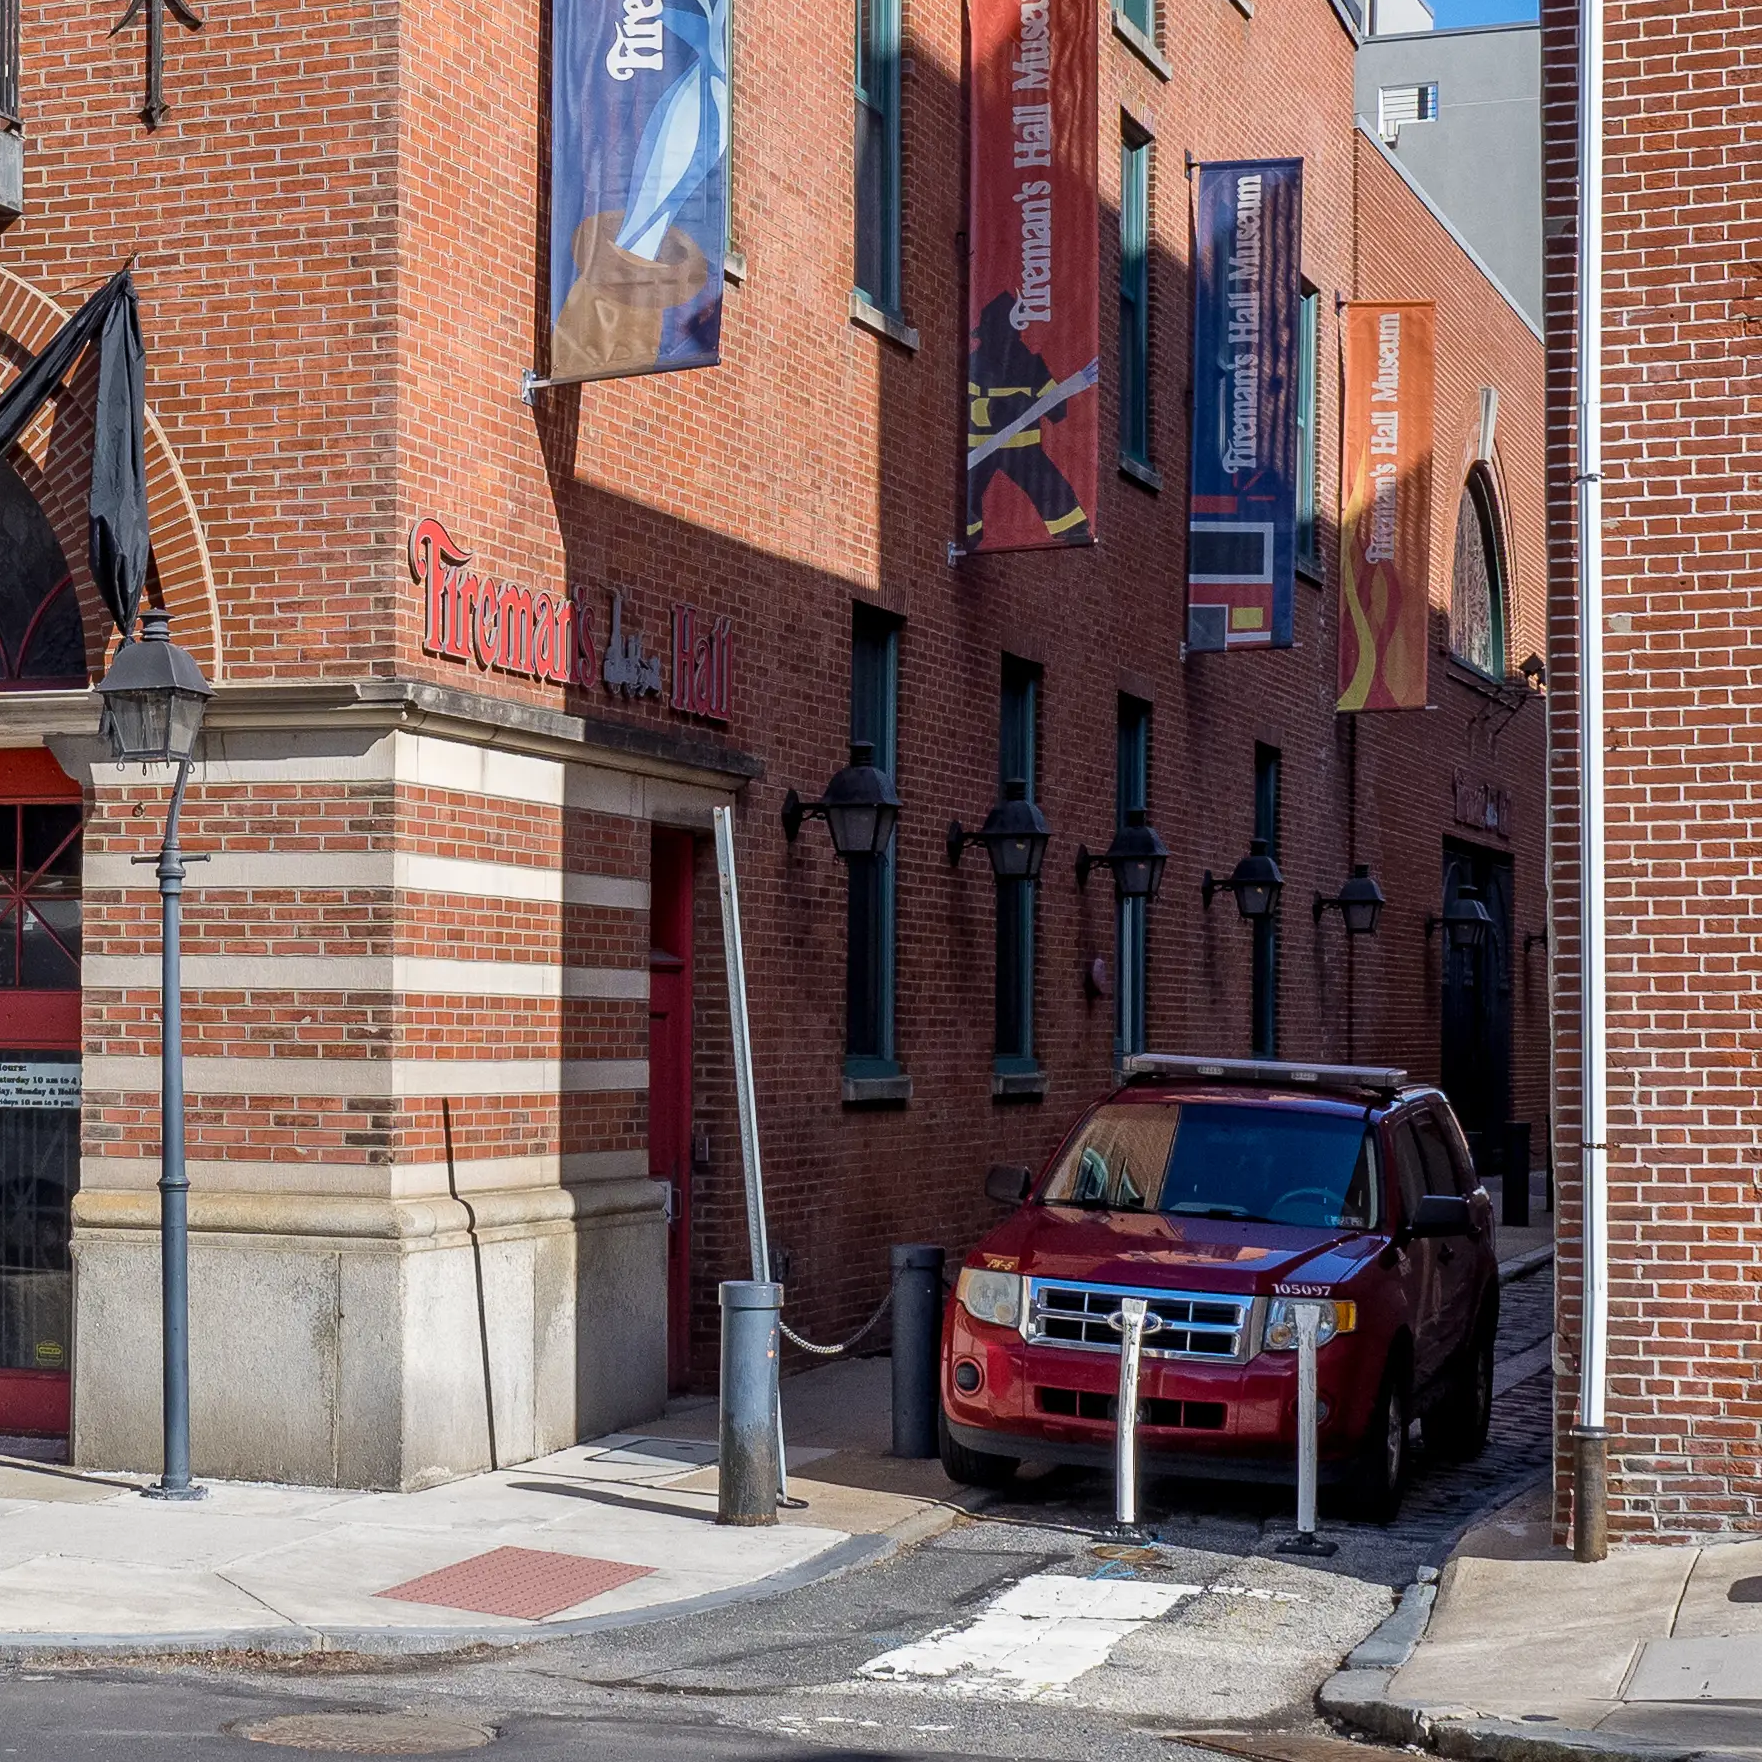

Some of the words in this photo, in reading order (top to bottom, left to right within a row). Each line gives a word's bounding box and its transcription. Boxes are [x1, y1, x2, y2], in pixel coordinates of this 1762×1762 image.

[1013, 102, 1052, 169] Hall
[1009, 180, 1052, 331] Fireman's
[1227, 174, 1262, 282] Museum
[1227, 291, 1260, 344] Hall
[1371, 312, 1401, 403] Museum
[1222, 353, 1259, 475] Fireman's
[1370, 410, 1399, 456] Hall
[1365, 462, 1398, 565] Fireman's
[409, 517, 596, 688] Fireman's
[670, 601, 734, 720] Hall
[15, 1087, 46, 1097] Monday
[48, 1087, 56, 1096] &
[32, 1076, 44, 1084] 10
[60, 1076, 69, 1084] to
[69, 1076, 77, 1085] 4
[1271, 1283, 1331, 1296] 105097
